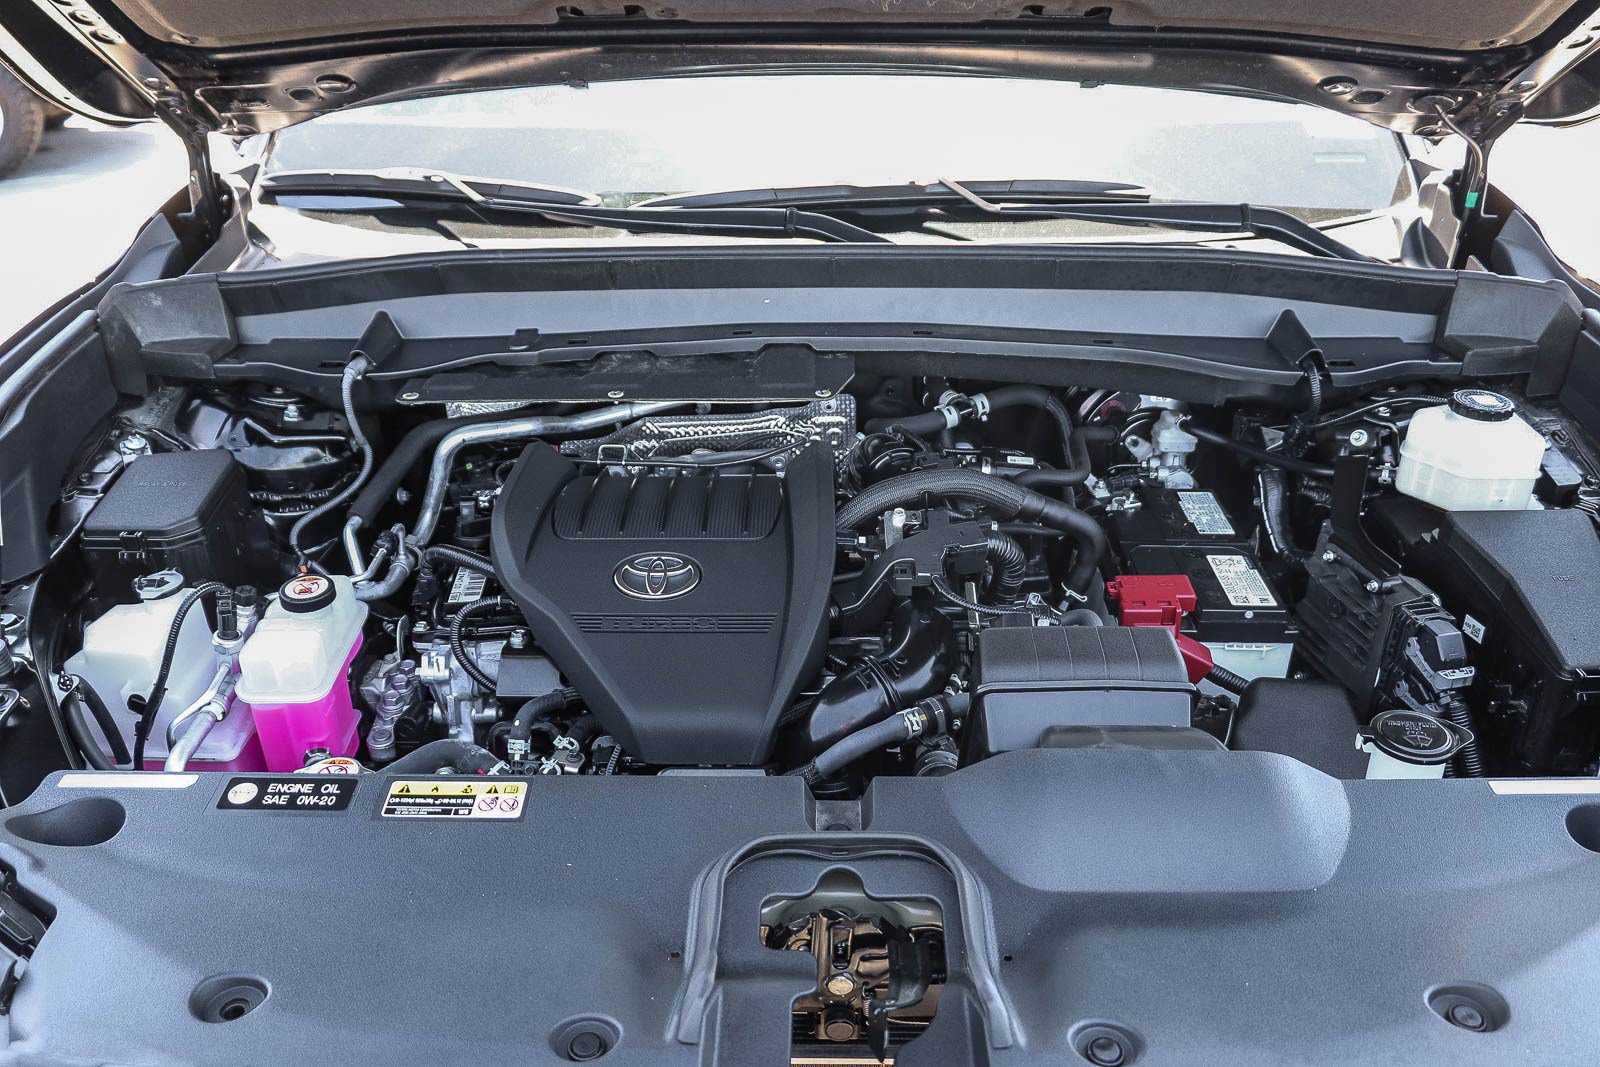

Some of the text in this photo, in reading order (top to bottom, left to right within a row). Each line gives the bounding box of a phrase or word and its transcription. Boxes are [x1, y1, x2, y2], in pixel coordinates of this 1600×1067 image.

[602, 616, 717, 631] TURBO
[267, 783, 341, 794] ENGINE OIL
[262, 794, 337, 806] SAE 0W-20
